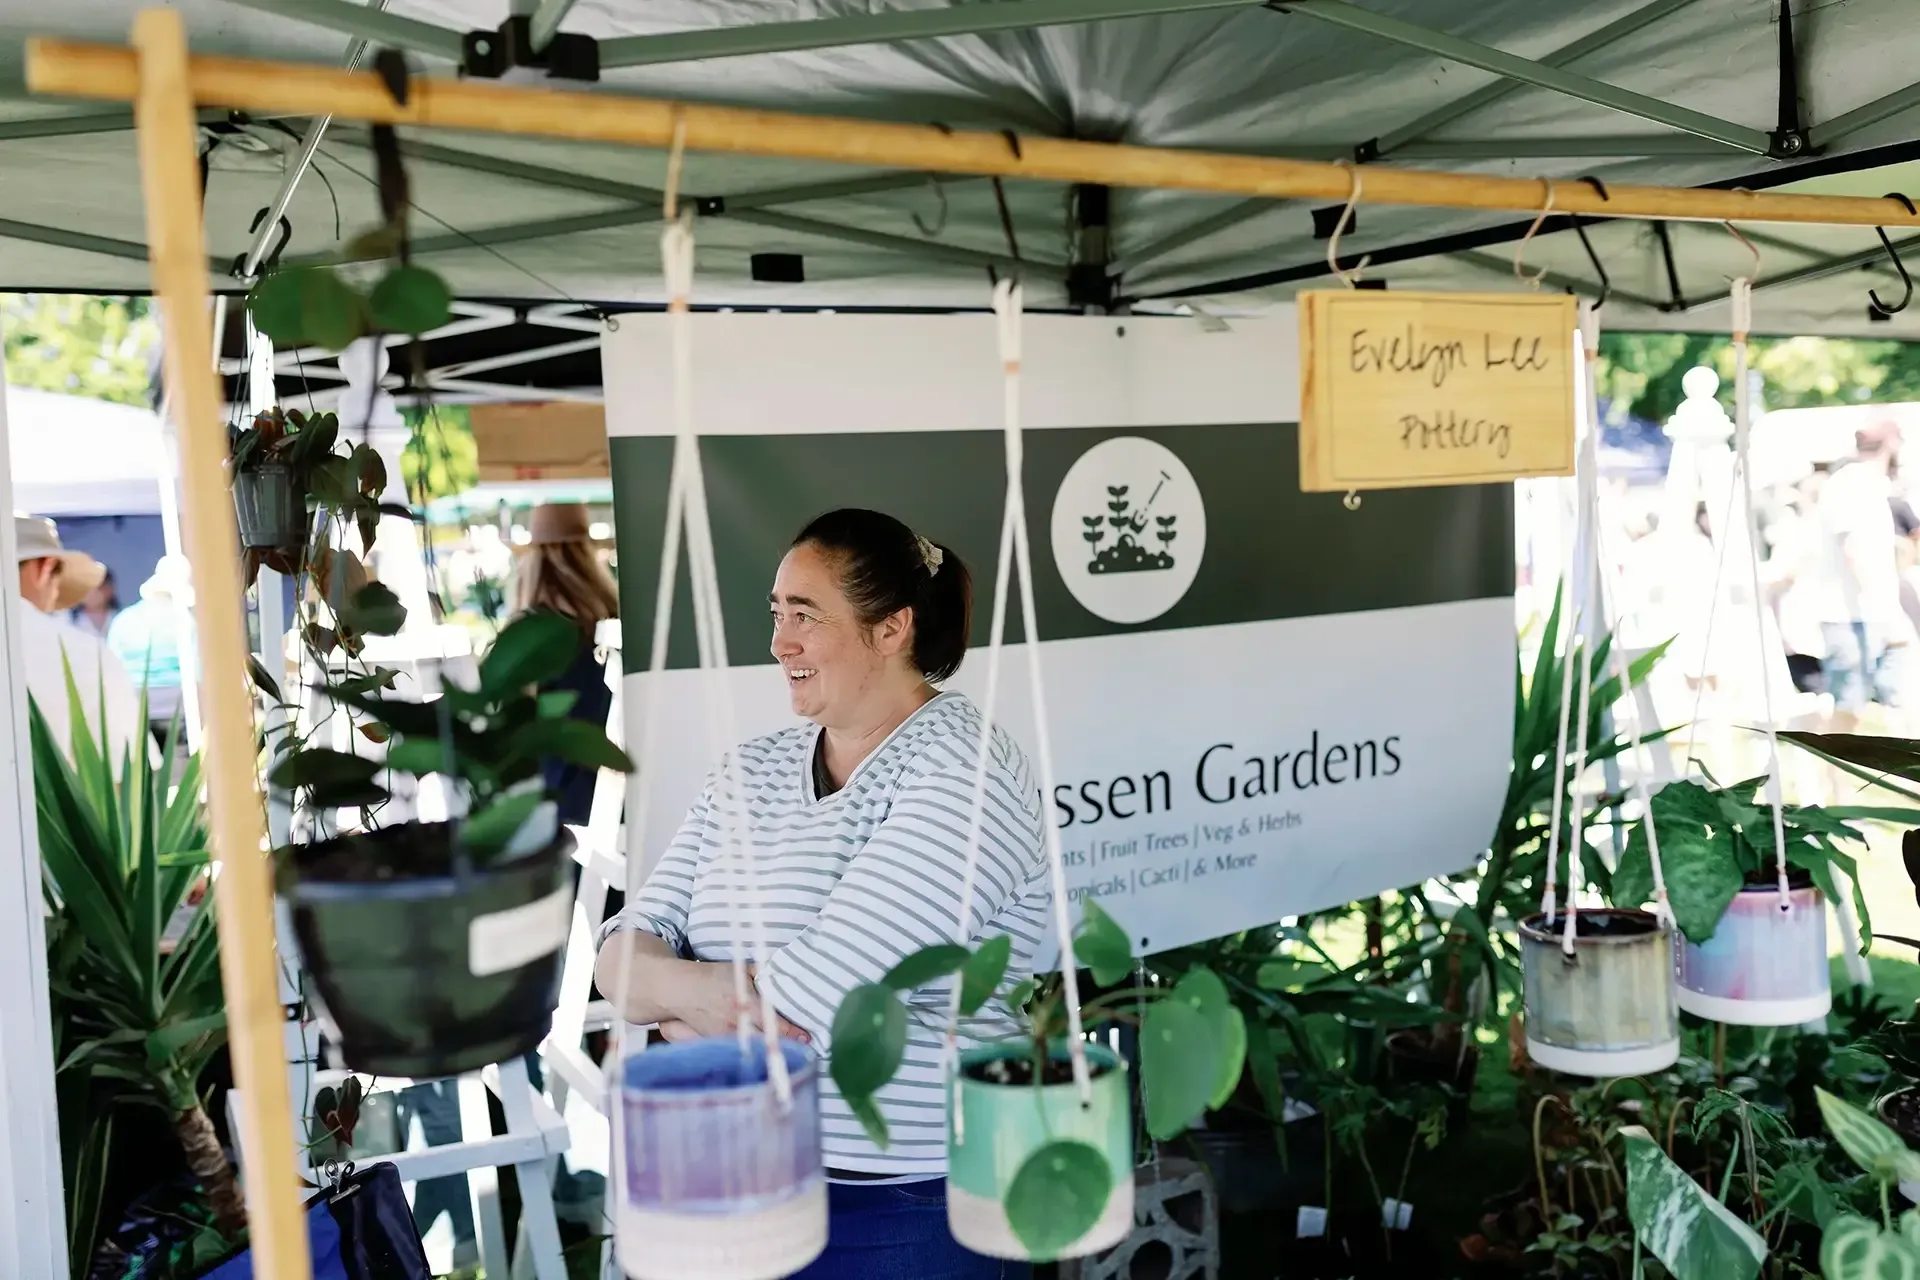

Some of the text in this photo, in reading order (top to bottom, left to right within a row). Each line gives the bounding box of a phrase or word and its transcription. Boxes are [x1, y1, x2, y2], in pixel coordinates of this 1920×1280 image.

[1350, 323, 1549, 388] Evelyn Lee
[1399, 410, 1513, 459] Pottery
[1037, 729, 1401, 829] ssen Gardens
[1060, 850, 1087, 868] nts
[1100, 839, 1137, 861] Fruit
[1144, 832, 1189, 852] Trees
[1202, 823, 1234, 845] Veg
[1237, 817, 1251, 837] &
[1258, 810, 1303, 834] Herbs
[1139, 864, 1180, 889] Cacti
[1192, 856, 1208, 878] &
[1214, 851, 1258, 874] More
